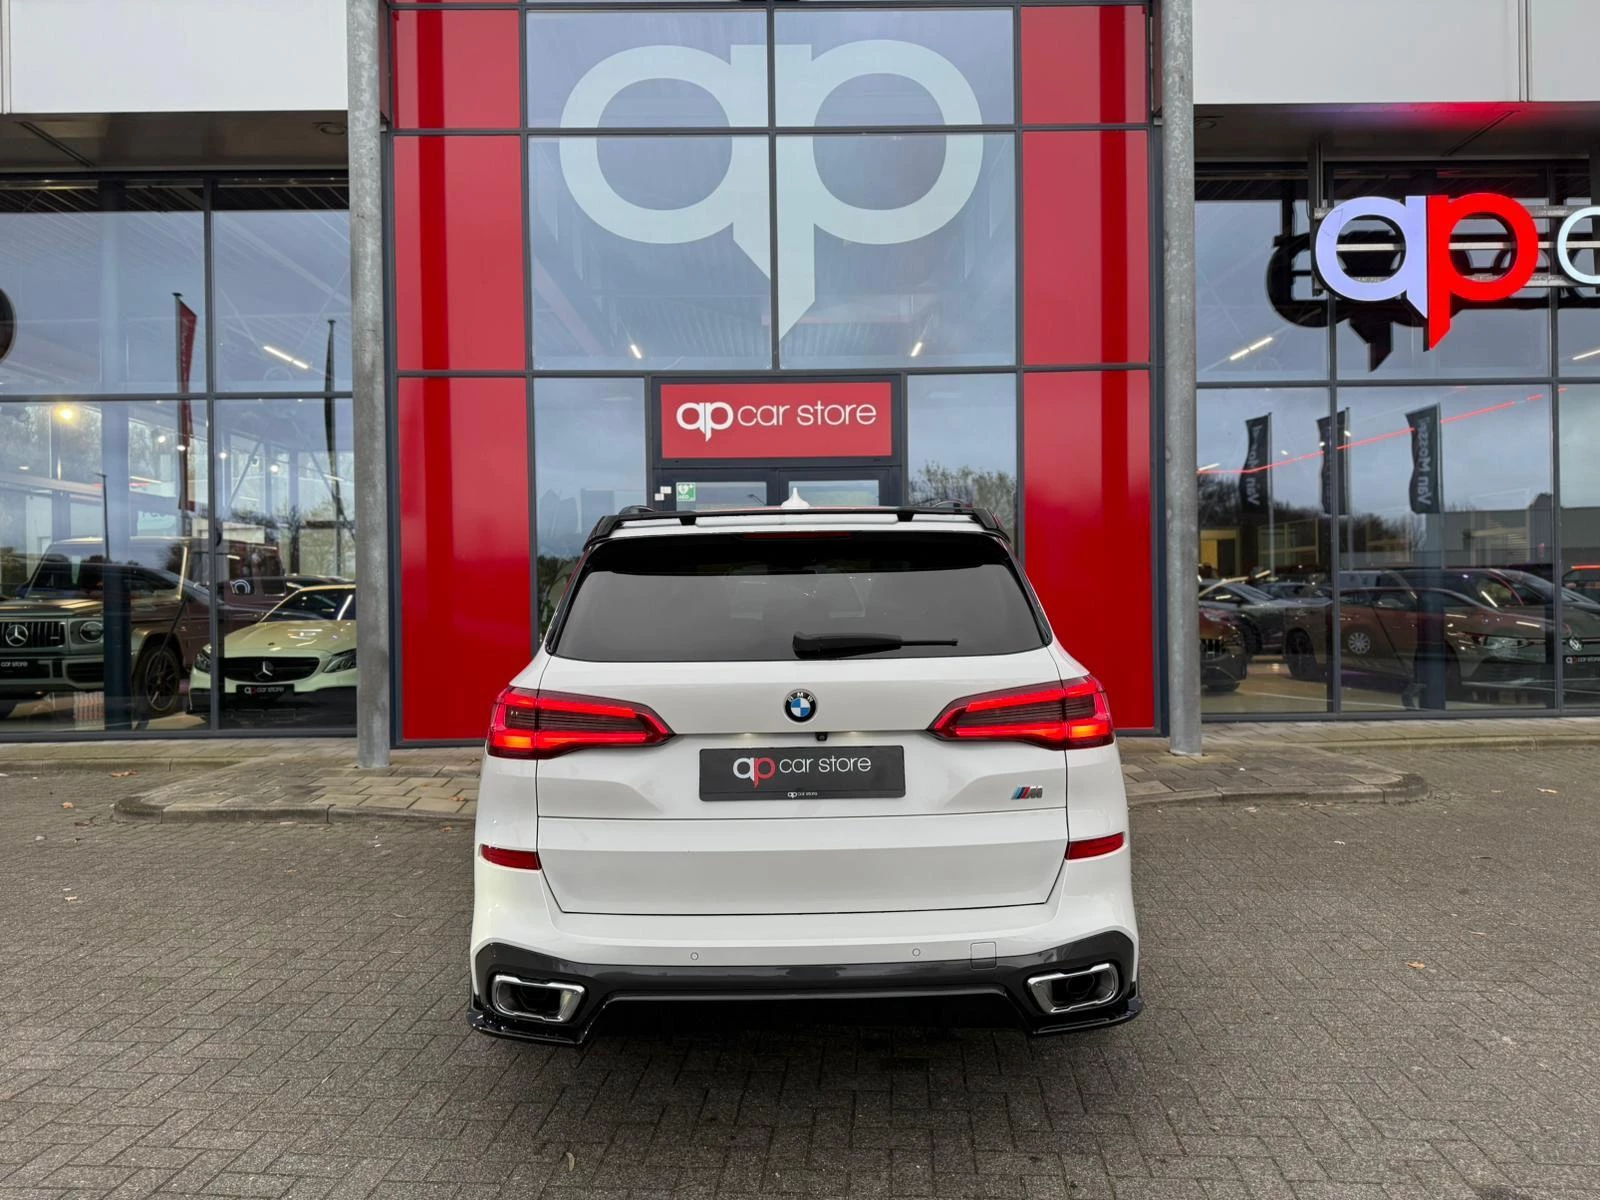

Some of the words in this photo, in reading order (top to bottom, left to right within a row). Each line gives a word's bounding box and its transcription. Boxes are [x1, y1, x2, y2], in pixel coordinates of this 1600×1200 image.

[737, 404, 791, 427] car
[796, 400, 877, 426] store
[779, 757, 814, 774] car
[818, 755, 872, 773] store
